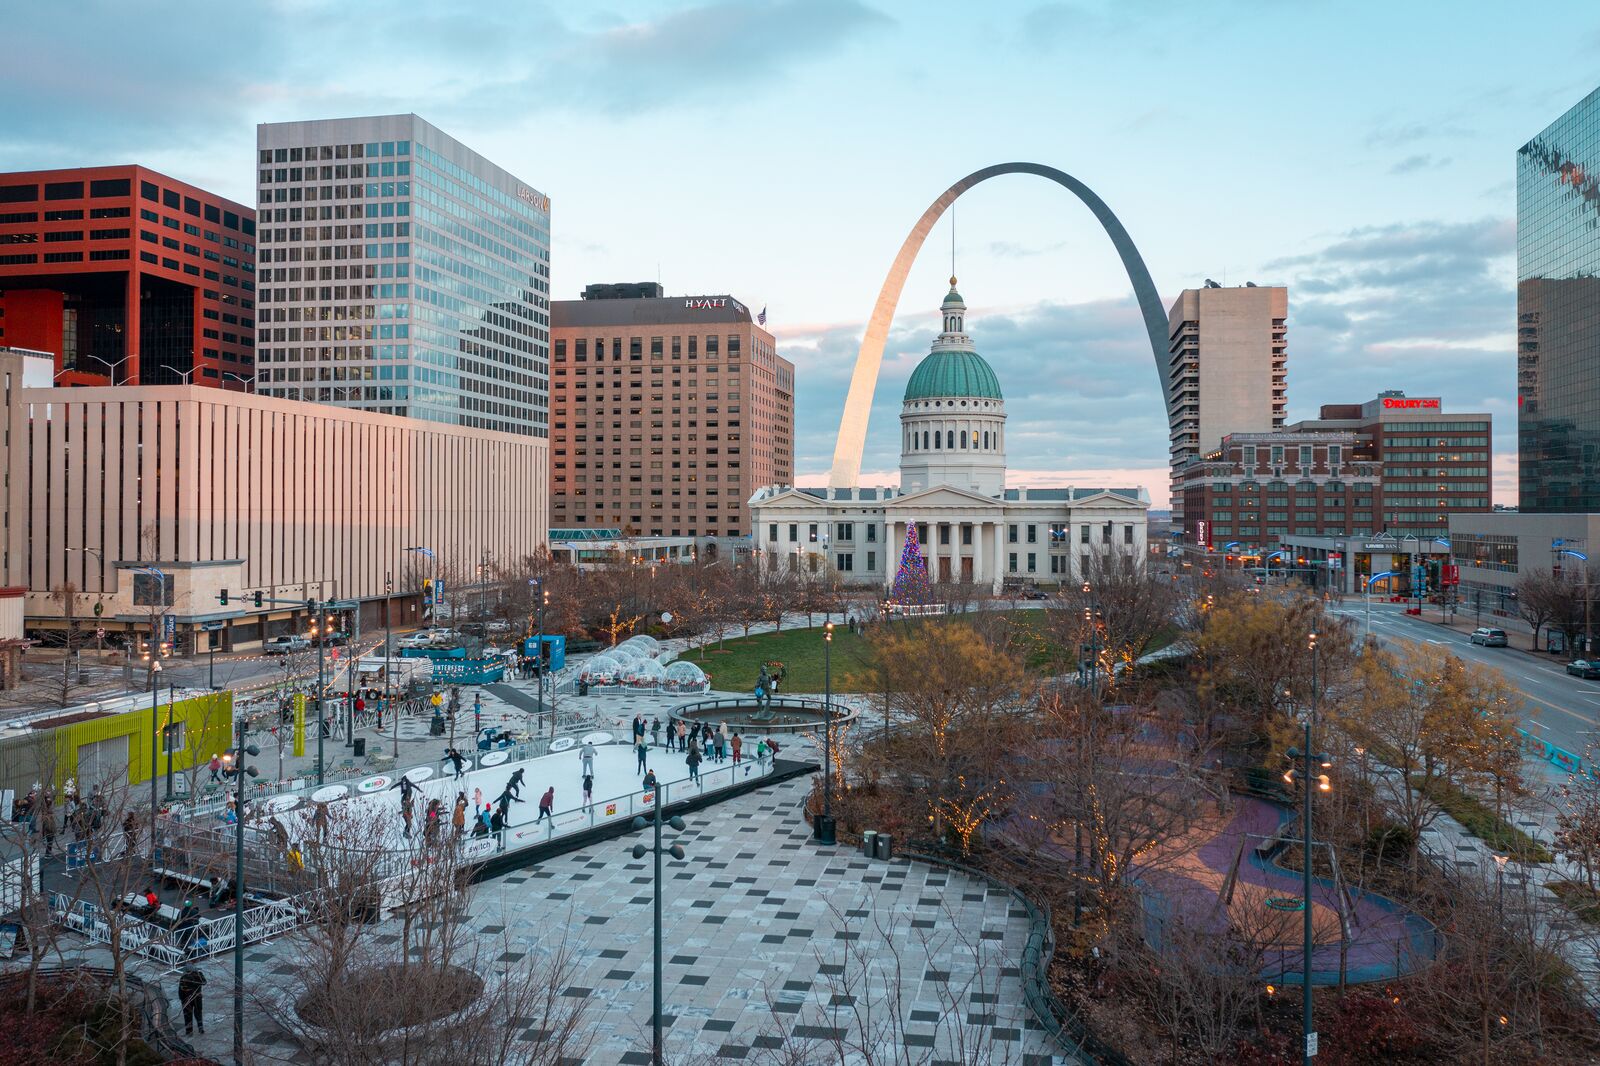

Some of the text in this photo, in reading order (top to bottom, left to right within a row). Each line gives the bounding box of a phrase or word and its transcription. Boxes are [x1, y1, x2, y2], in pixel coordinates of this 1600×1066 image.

[517, 183, 543, 209] LARSON
[685, 298, 727, 309] HYATT
[1383, 398, 1423, 409] DRURY
